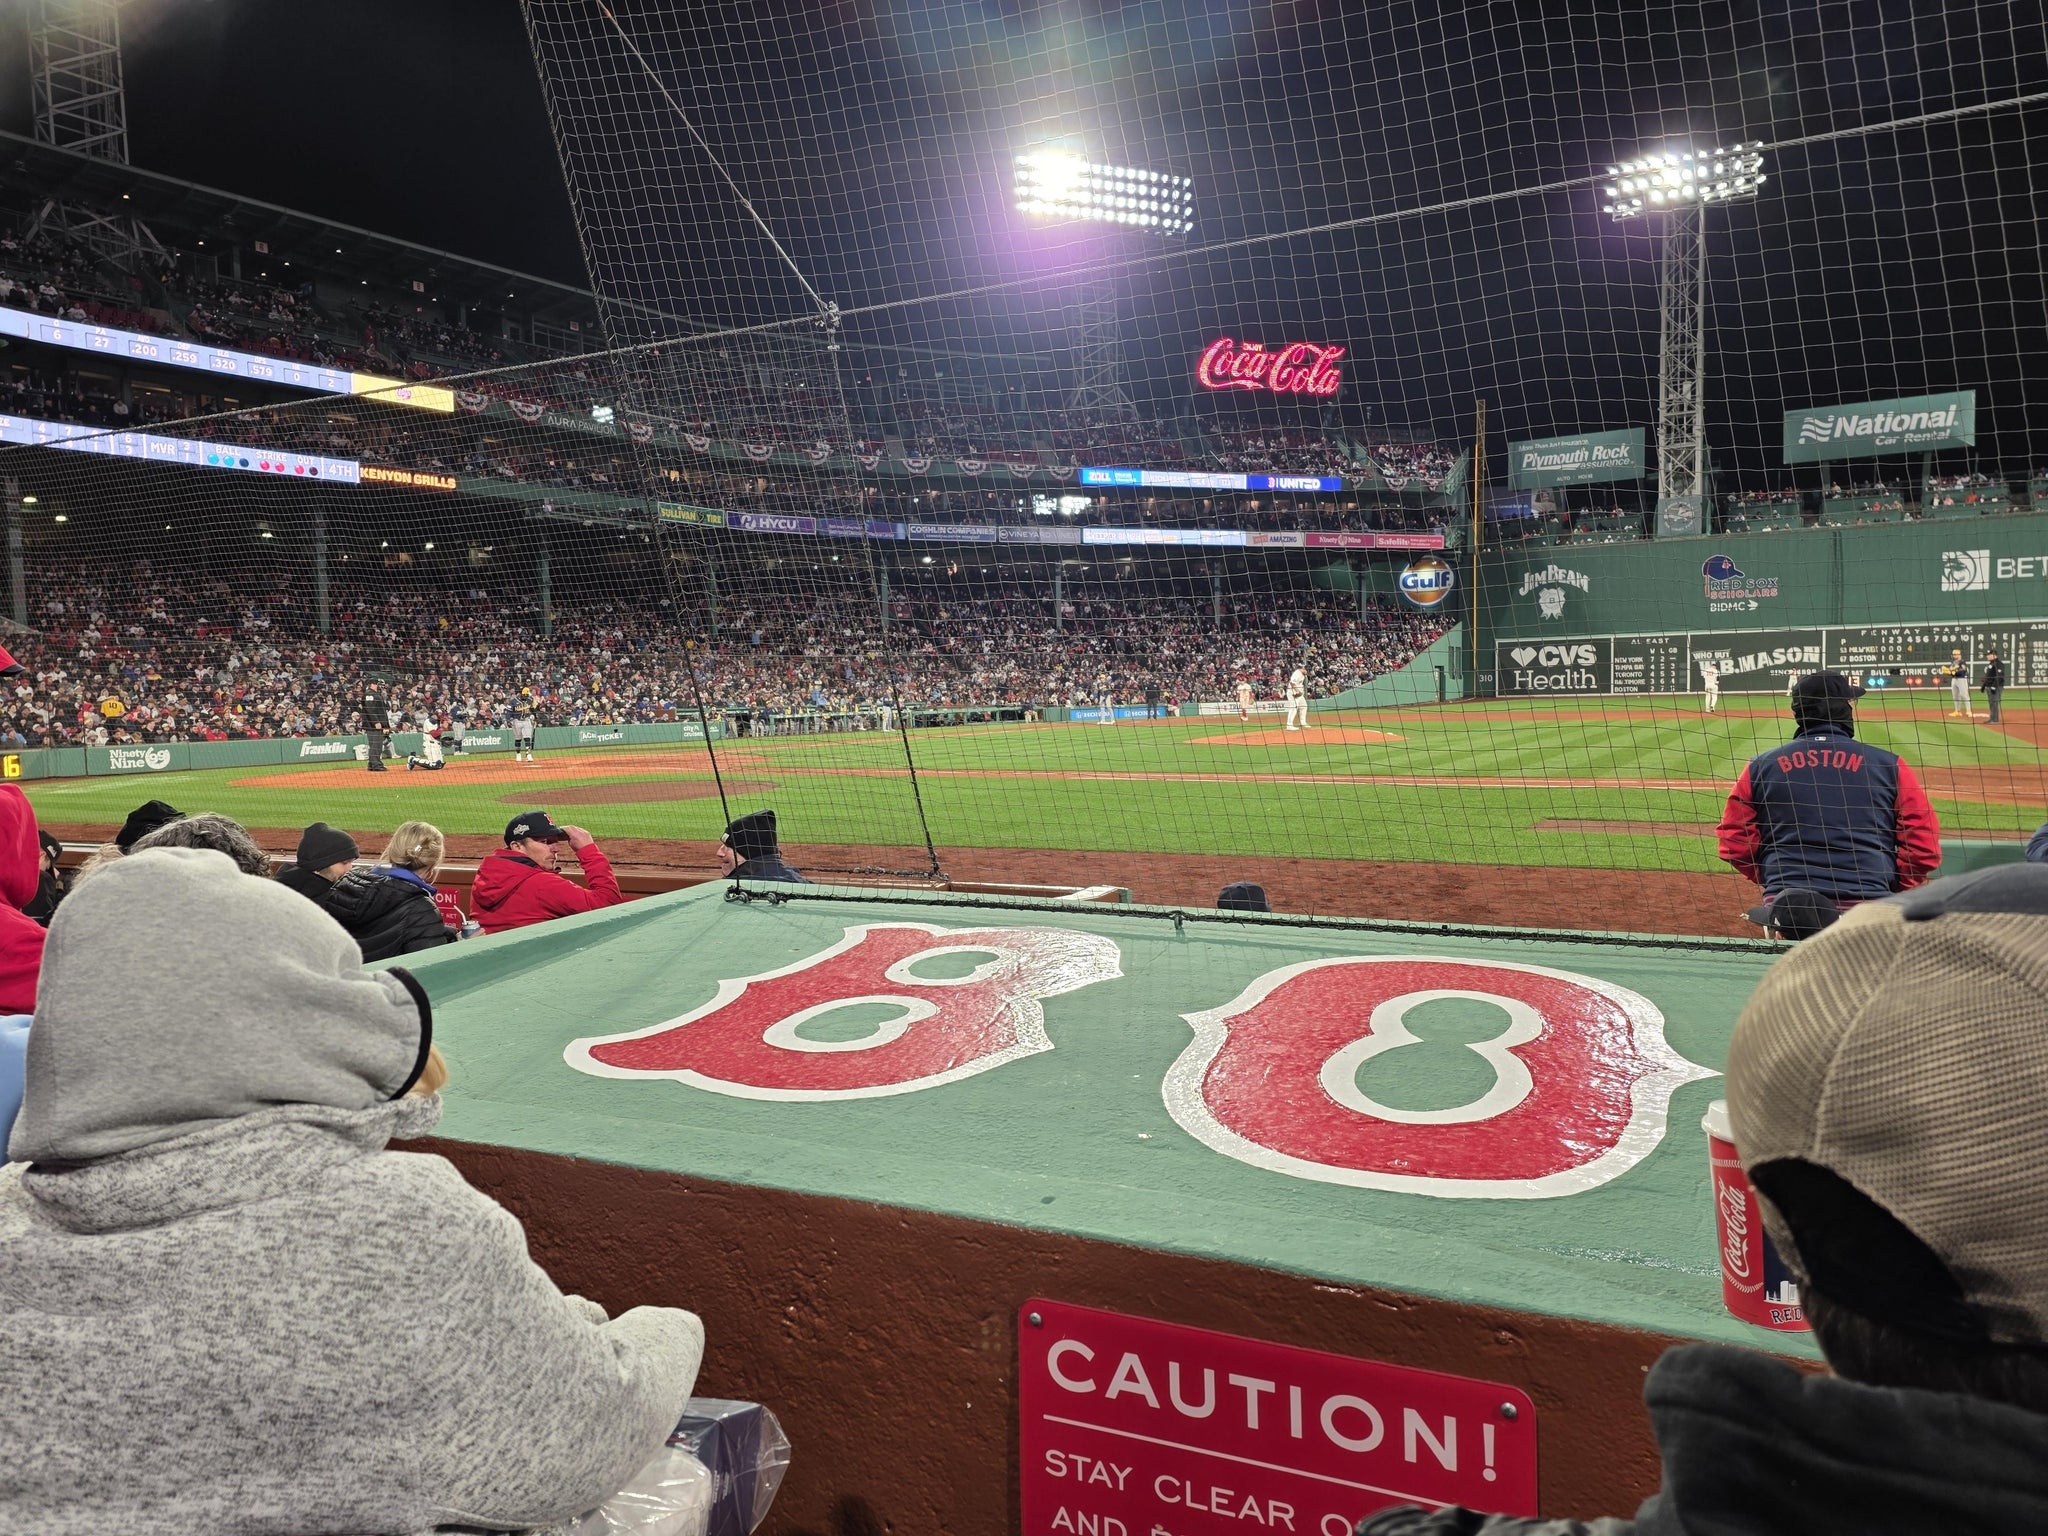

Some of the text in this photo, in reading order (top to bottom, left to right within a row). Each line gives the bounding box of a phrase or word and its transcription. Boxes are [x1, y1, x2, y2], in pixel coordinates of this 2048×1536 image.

[54, 330, 61, 340] 6
[95, 338, 109, 348] 27
[131, 344, 157, 356] .200
[172, 352, 197, 363] .259
[212, 358, 235, 370] .320
[250, 365, 272, 377] .579
[548, 415, 577, 428] AURA
[1834, 404, 1957, 438] National
[39, 423, 46, 433] 4
[1875, 429, 1950, 446] Car Rental
[151, 443, 175, 455] MVR
[183, 442, 190, 451] 3
[215, 445, 314, 465] BALL STRIKE OUT
[1523, 443, 1630, 469] Plymouth Rock
[329, 465, 353, 477] 4TH
[1089, 472, 1111, 482] ZOLL
[360, 467, 456, 489] KENYON GRILLS
[1280, 478, 1321, 489] UNITED
[661, 509, 721, 524] SULLIVAN TIRE
[760, 517, 797, 529] HYCU
[910, 525, 995, 535] COGHLIN COMPANIES
[1269, 535, 1297, 543] AMAZING
[1402, 571, 1450, 589] Gulf
[1519, 565, 1589, 596] JIM BEAM
[1710, 578, 1778, 591] RED SOX
[1710, 588, 1778, 600] SCHOLARS
[1710, 602, 1746, 612] BIDMC
[1861, 628, 1920, 636] FENWAY
[1960, 634, 1969, 642] 10
[1539, 645, 1597, 667] CVS
[1693, 652, 1712, 660] WHO
[1900, 668, 1927, 676] STRIKE
[1513, 668, 1597, 690] Health
[598, 733, 624, 742] TICKET
[109, 749, 146, 758] Ninety
[300, 742, 347, 757] Franklin
[3, 755, 21, 777] 16
[110, 758, 145, 769] Nine
[1777, 750, 1864, 773] BOSTON
[1769, 1307, 1803, 1324] RED
[1047, 1339, 1496, 1482] CAUTION!
[1045, 1449, 1133, 1491] STAY
[1154, 1475, 1296, 1531] CLEAR
